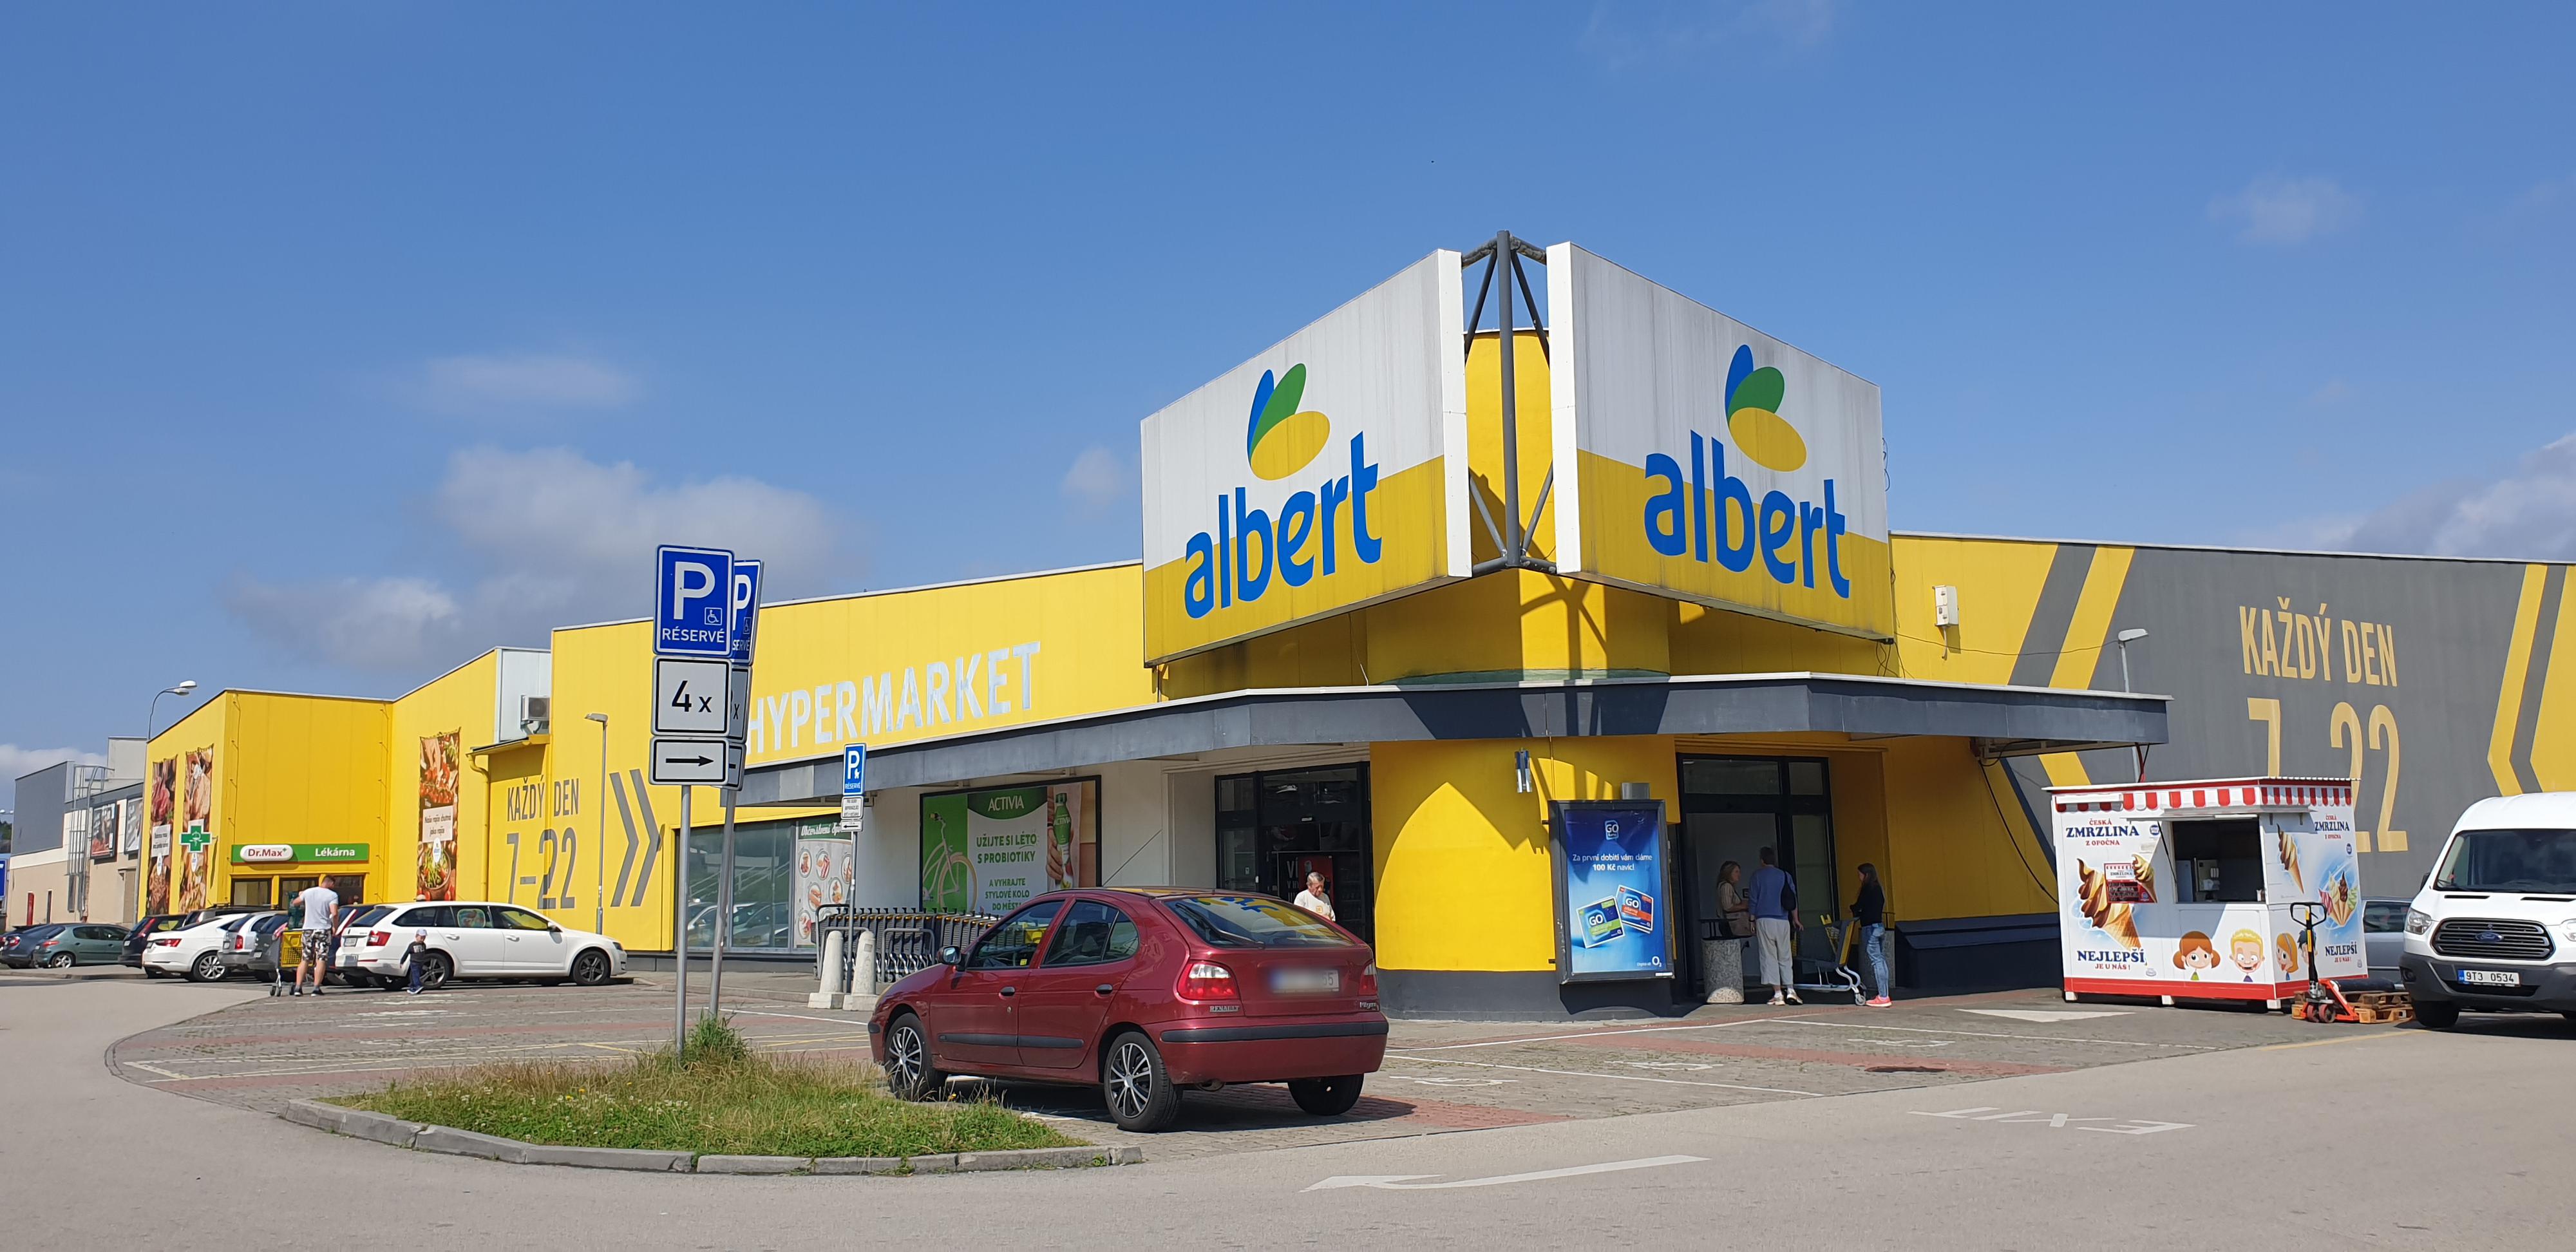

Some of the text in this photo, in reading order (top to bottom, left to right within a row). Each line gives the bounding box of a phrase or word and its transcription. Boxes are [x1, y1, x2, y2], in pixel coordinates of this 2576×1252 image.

[1644, 430, 1850, 599] albert
[1184, 431, 1382, 618] albert
[674, 561, 715, 620] P
[662, 626, 725, 643] RÉSERVÉ
[732, 639, 750, 652] SERVÉ
[2239, 596, 2397, 687] KAŽDÝ DEN
[748, 641, 1041, 754] HYPERMARKET
[848, 750, 860, 779] P
[507, 775, 579, 822] KAŽDÝ DEN
[988, 795, 1025, 811] ACTIVIA
[1605, 824, 1619, 833] GO
[2066, 826, 2139, 838] ZMRZLINA
[2315, 821, 2350, 831] ZMRZLINA
[976, 831, 1037, 848] UŽIJTE SI LÉTO
[315, 848, 355, 857] Lékárna
[977, 851, 1036, 864] S PROBIOTIKY
[1582, 854, 1599, 862] první
[994, 878, 1025, 887] VYHRAJTE
[985, 889, 1011, 899] STYLOVÉ
[1626, 898, 1639, 908] GO
[1589, 915, 1604, 925] GO
[2078, 949, 2145, 962] NEJLEPŠÍ
[2325, 942, 2358, 956] NEJLEPŠÍ
[2466, 971, 2514, 982] 9T3 0534
